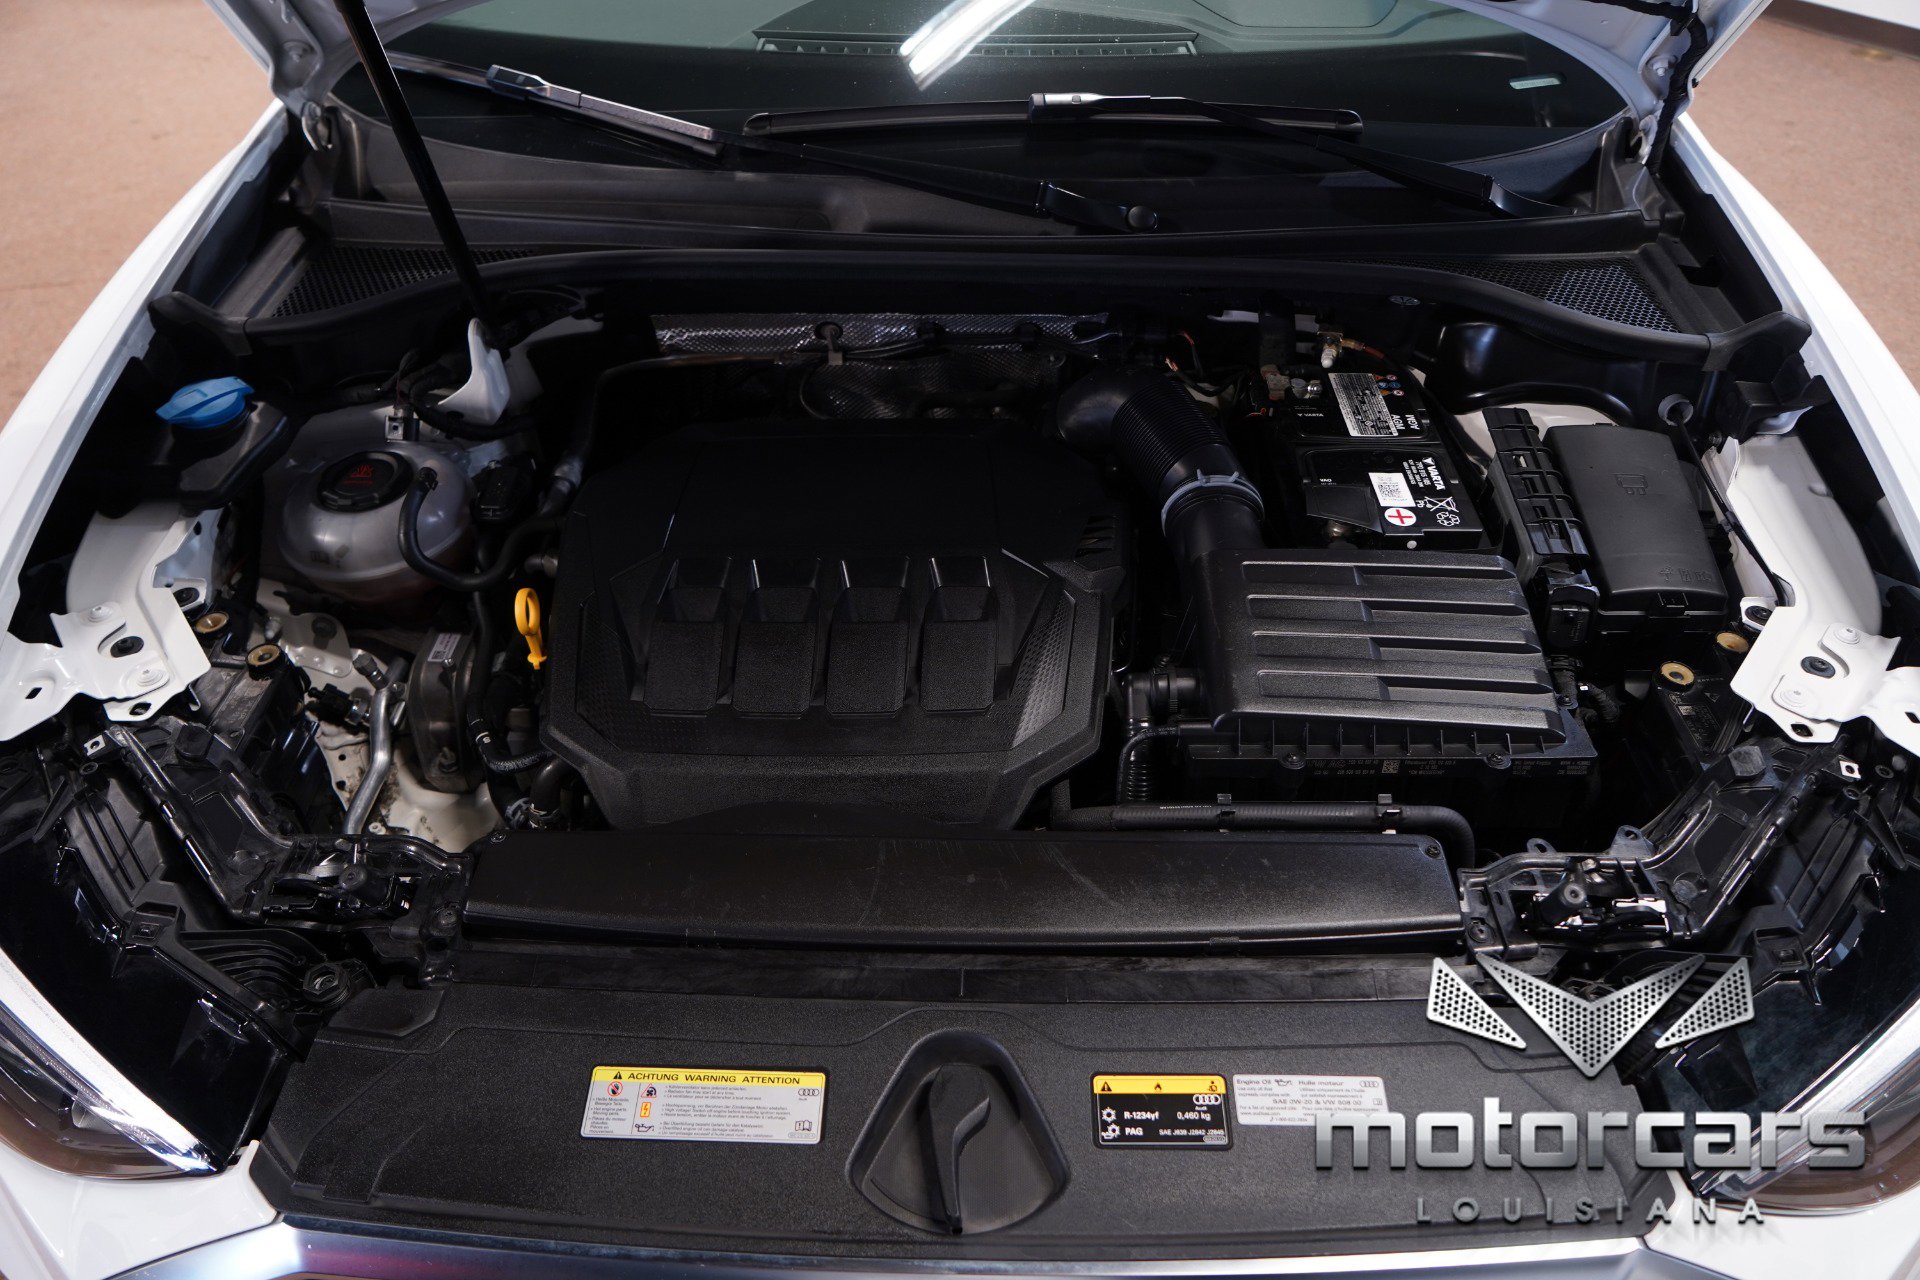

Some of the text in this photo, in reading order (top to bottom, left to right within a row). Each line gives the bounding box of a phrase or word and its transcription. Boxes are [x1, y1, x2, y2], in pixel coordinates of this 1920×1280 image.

[1427, 465, 1446, 490] VARTA
[1415, 500, 1425, 508] Pb
[628, 1073, 800, 1085] ACHTUNG WARNING ATTENTION
[1123, 1111, 1160, 1121] R-1234yf
[1200, 1111, 1211, 1122] kg
[1125, 1127, 1144, 1136] PAG
